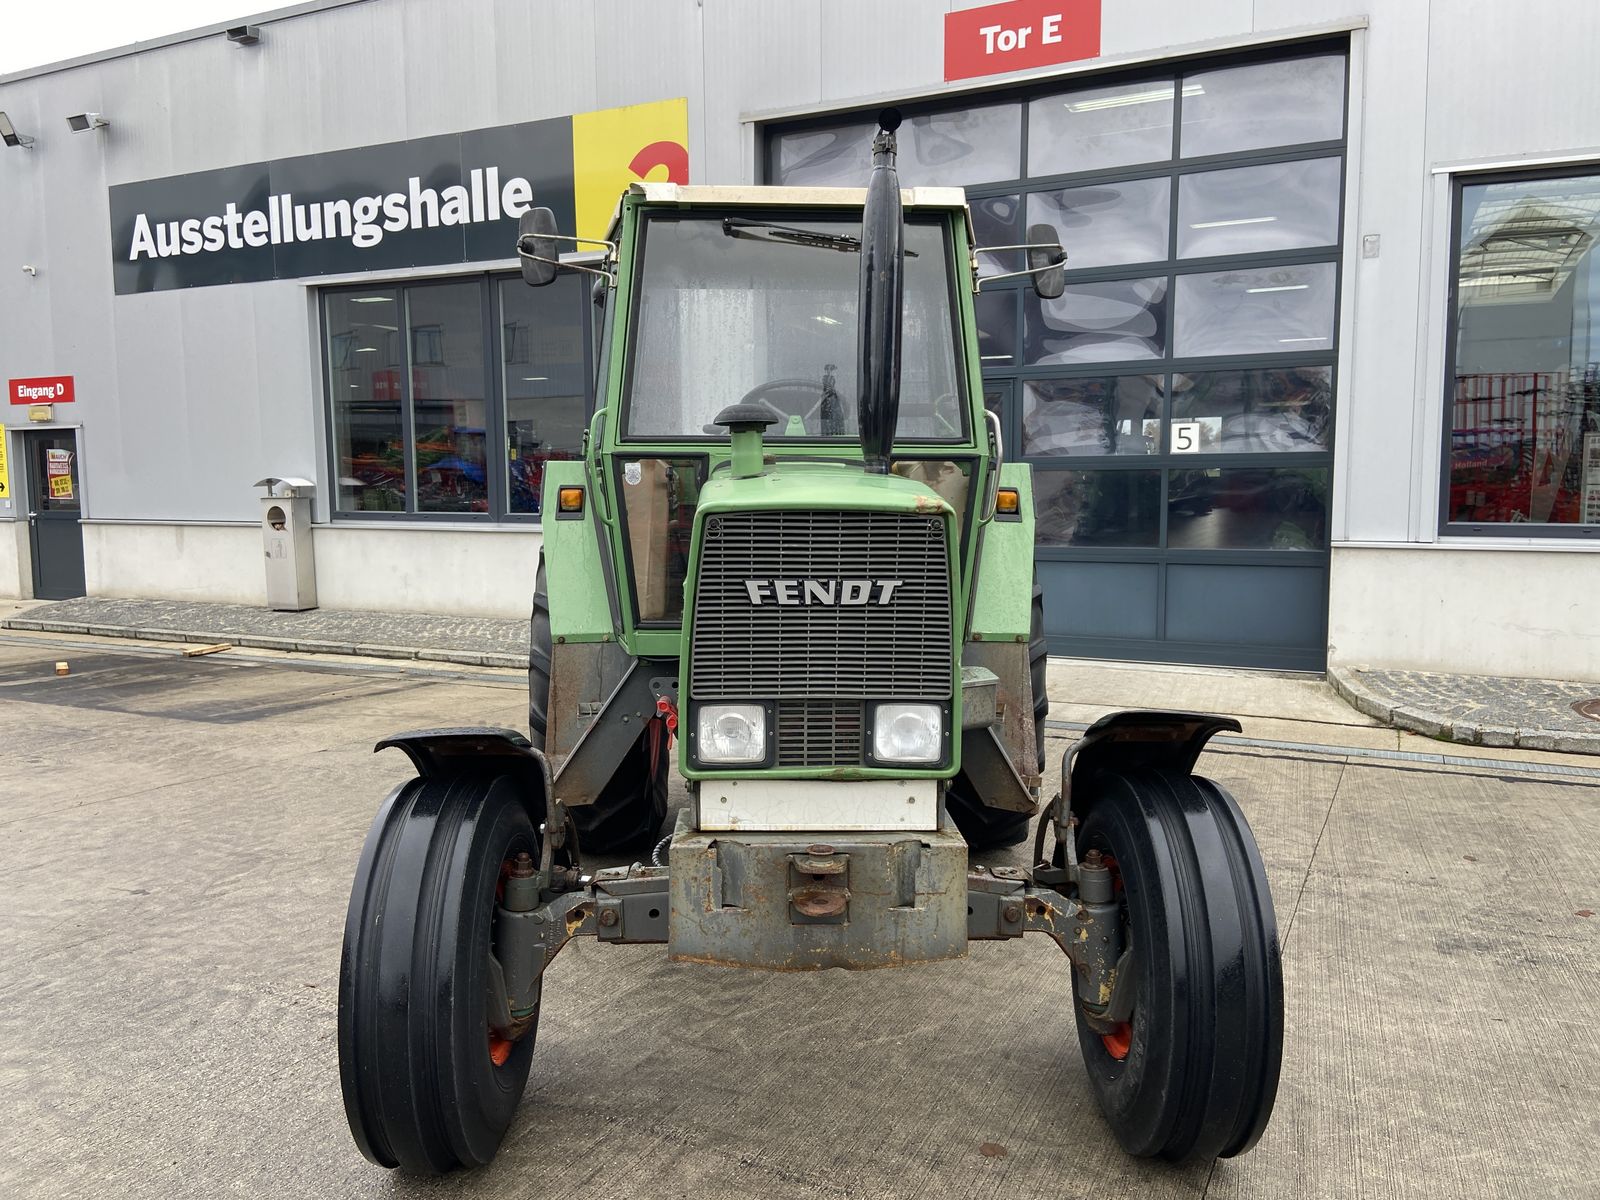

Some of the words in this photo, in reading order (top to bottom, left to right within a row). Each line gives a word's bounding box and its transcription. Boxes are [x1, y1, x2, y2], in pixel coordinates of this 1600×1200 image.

[979, 24, 1032, 55] Tor
[1041, 13, 1063, 45] E
[129, 166, 534, 261] Ausstellungshalle
[17, 384, 55, 399] Eingang
[56, 383, 65, 396] D
[1176, 427, 1192, 450] 5
[744, 579, 904, 606] FENDT
